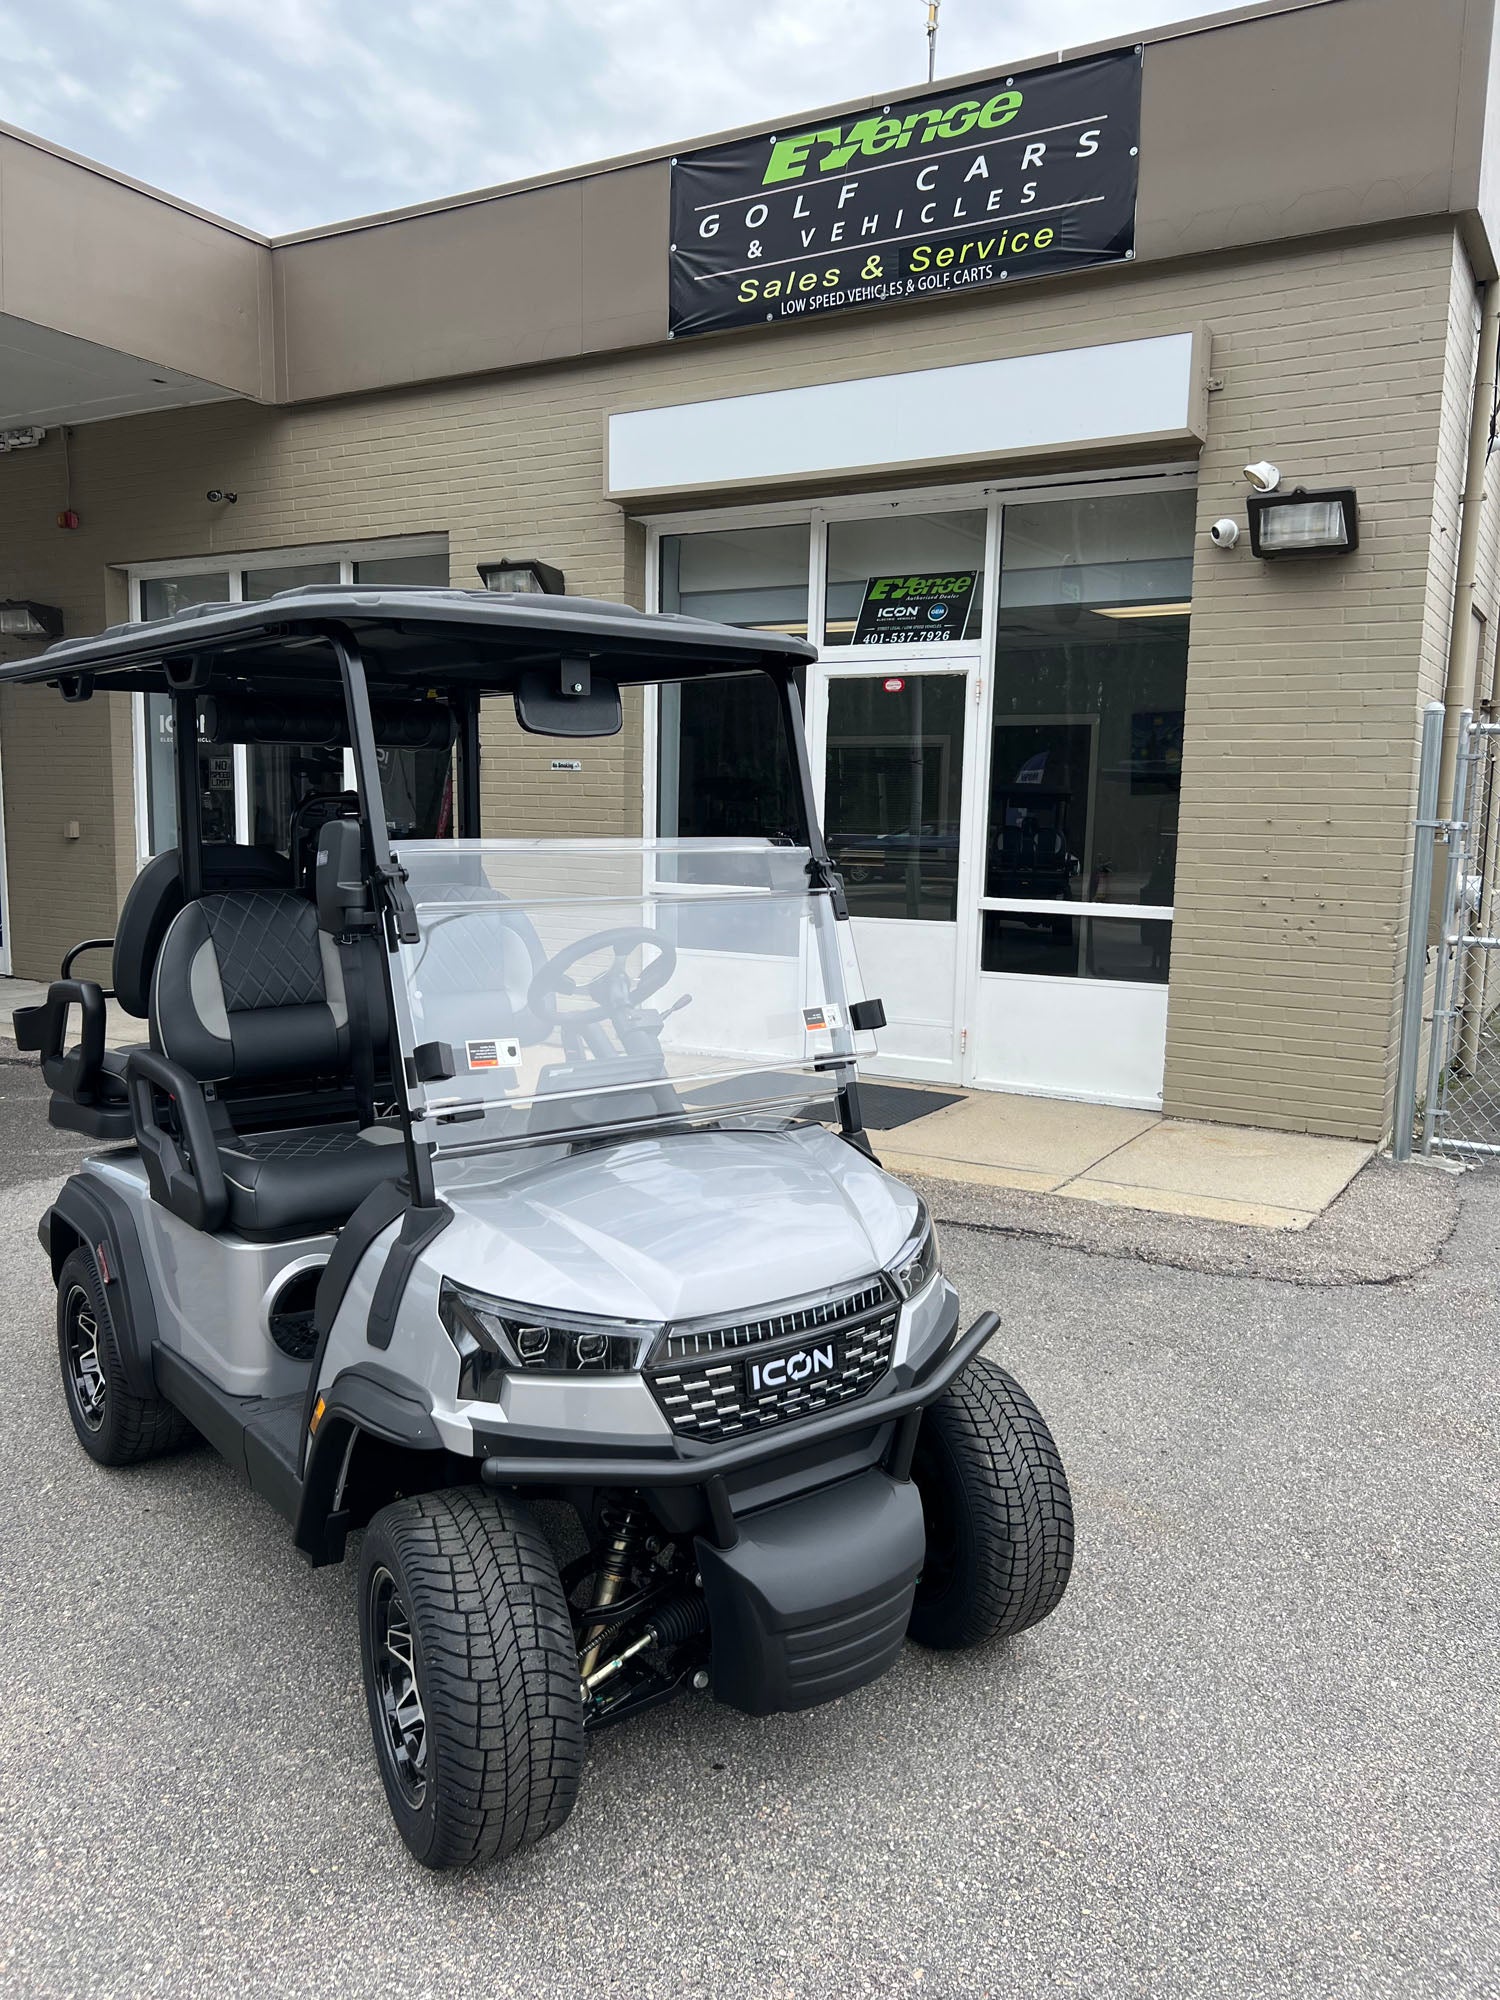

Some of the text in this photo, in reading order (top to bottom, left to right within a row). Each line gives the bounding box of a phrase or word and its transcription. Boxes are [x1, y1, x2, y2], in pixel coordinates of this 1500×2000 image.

[699, 130, 1100, 238] GOLF CARS
[747, 182, 1037, 259] & VEHICLES
[737, 227, 1054, 303] Sales & Service
[781, 264, 993, 315] LOW SPEED VEHICLES & GOLF CARTS
[877, 606, 919, 618] ICON
[863, 630, 951, 644] 401-537-7926
[214, 760, 228, 771] NO
[752, 1344, 834, 1391] ICON
